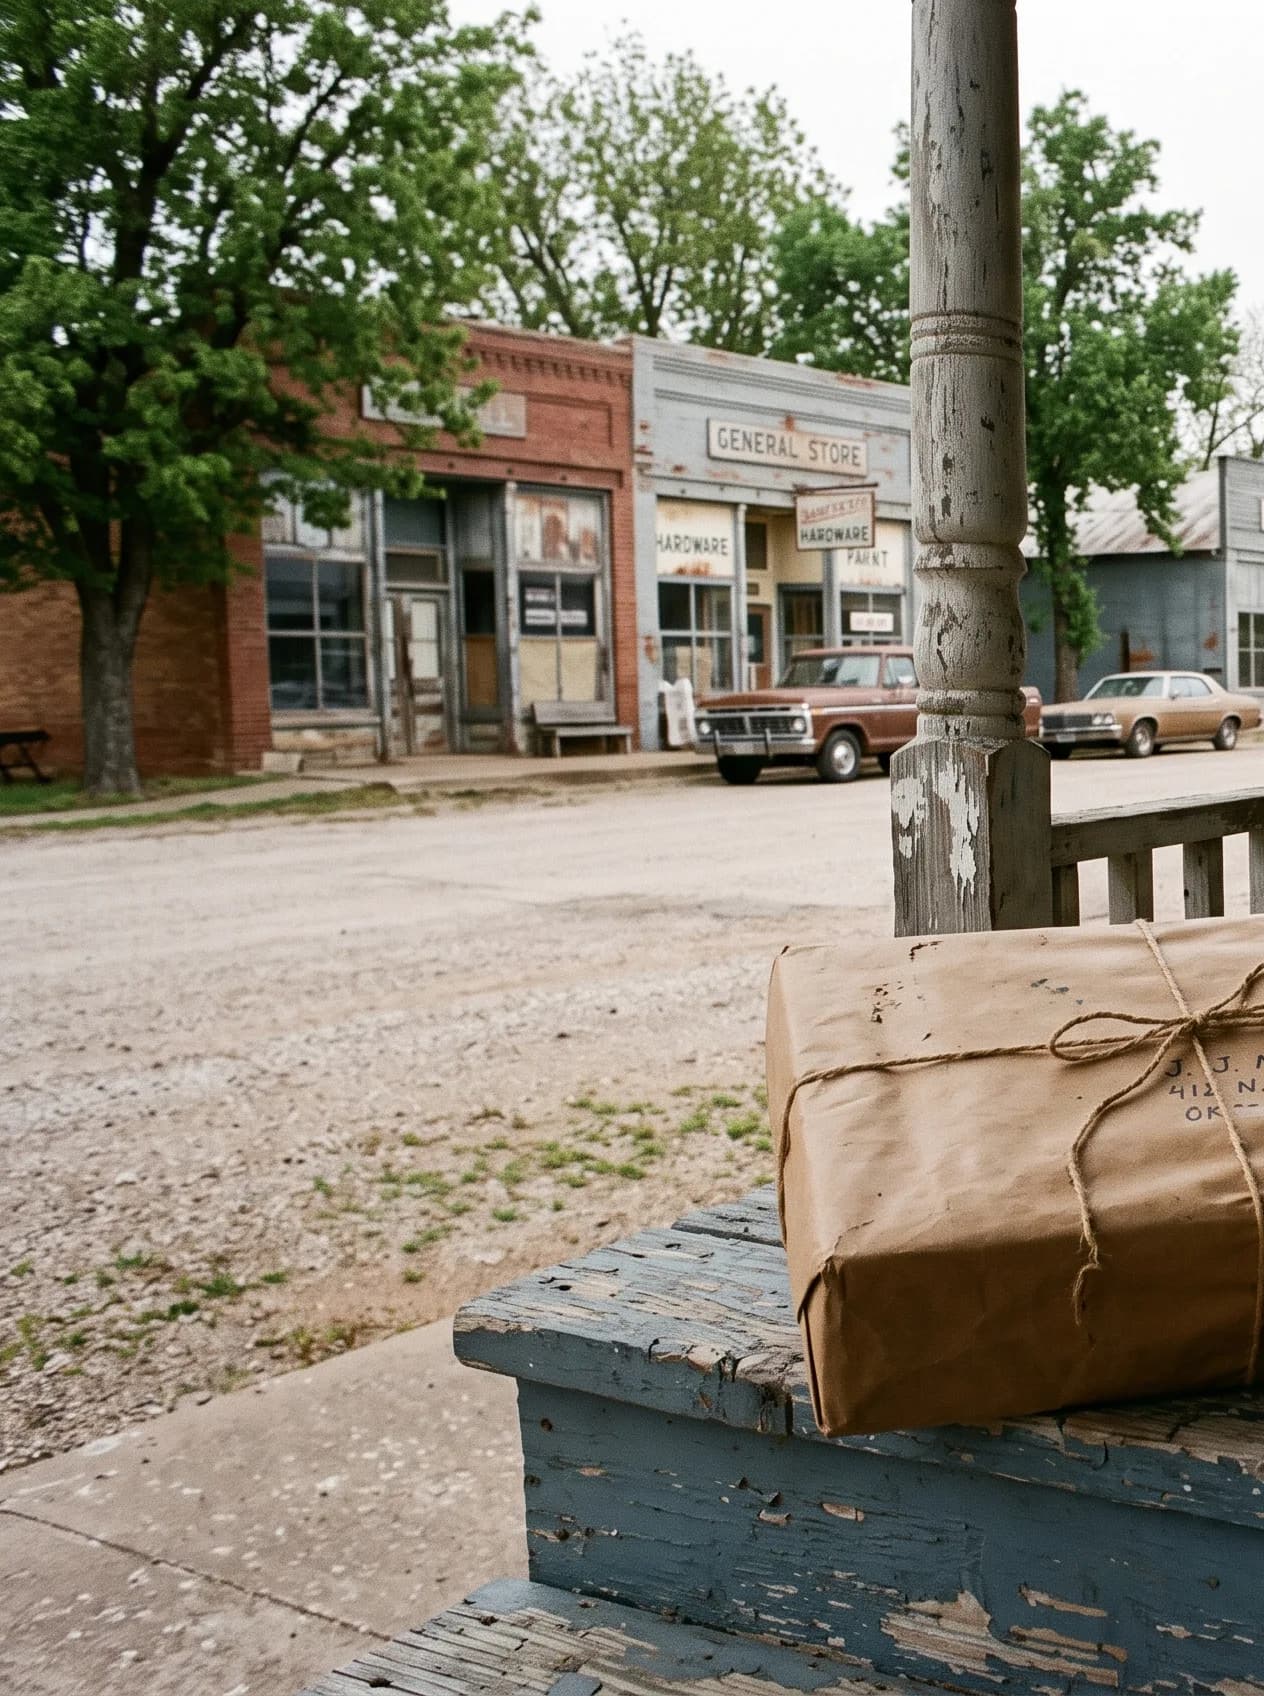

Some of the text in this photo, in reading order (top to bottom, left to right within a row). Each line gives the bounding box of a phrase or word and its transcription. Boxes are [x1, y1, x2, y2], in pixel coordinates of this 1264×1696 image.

[717, 427, 861, 467] GENERAL STORE
[656, 533, 729, 556] HARDWARE
[1164, 1058, 1192, 1077] J.
[1212, 1055, 1239, 1073] J.
[1168, 1082, 1216, 1100] 412
